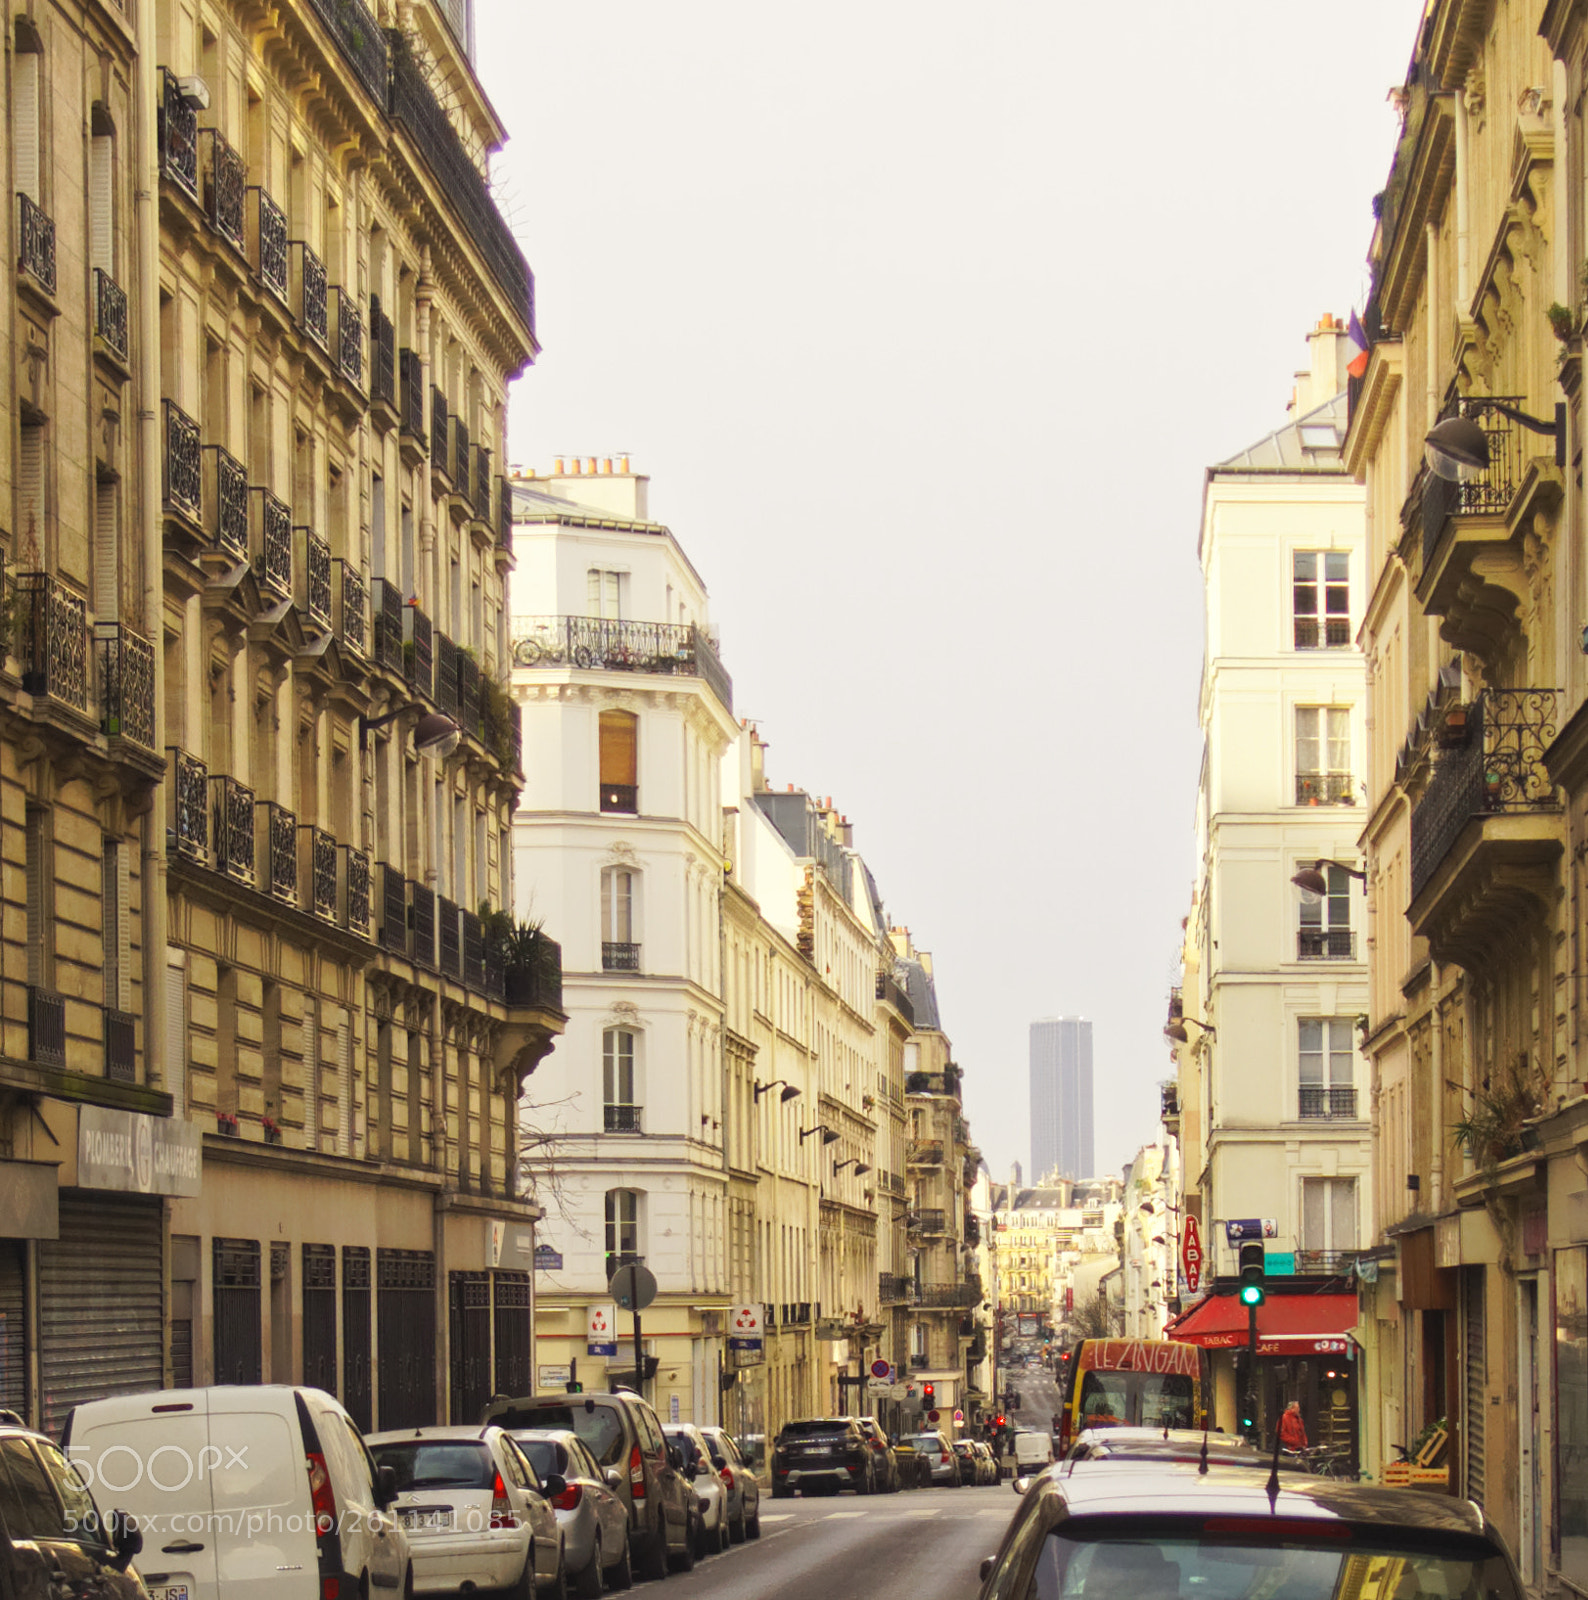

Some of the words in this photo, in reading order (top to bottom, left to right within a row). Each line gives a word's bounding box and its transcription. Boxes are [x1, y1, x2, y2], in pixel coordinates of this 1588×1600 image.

[154, 1141, 198, 1179] CHAUFFAGE
[1187, 1220, 1200, 1289] TABAC
[1203, 1335, 1234, 1345] TABAC
